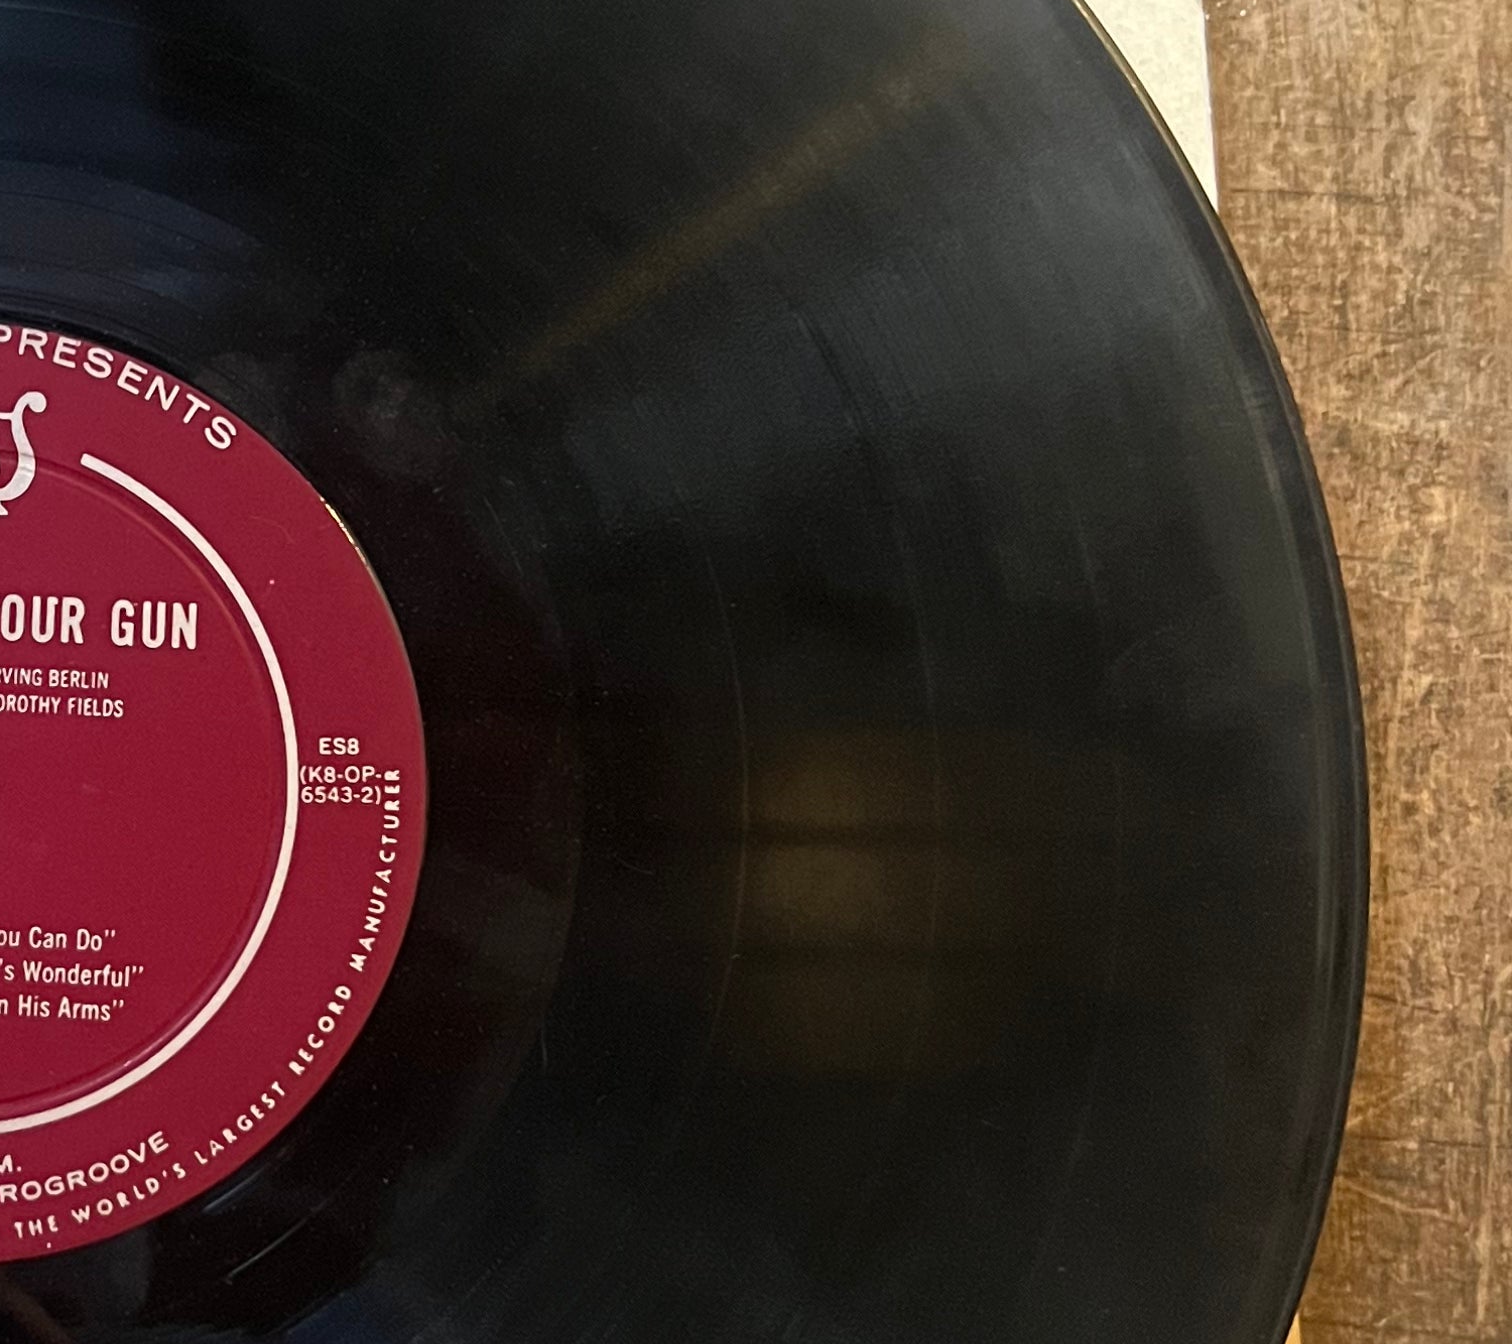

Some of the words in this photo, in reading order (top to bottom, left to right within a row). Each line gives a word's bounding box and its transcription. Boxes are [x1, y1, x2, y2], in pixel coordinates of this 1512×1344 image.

[110, 598, 198, 650] GUN
[48, 668, 109, 689] BERLIN
[67, 696, 124, 719] FIELDS
[318, 736, 360, 756] ES8
[299, 765, 382, 785] (K8-OP-
[300, 785, 382, 806] 6543-2)
[28, 925, 68, 950] Can
[75, 928, 116, 952] Do"
[22, 959, 145, 988] Wonderful"
[13, 1214, 59, 1239] THE
[70, 1162, 187, 1224] WORLD'S
[193, 1080, 286, 1166] LARGEST
[288, 985, 352, 1076] RECORD
[348, 769, 401, 973] MANUFACTURER
[17, 993, 51, 1018] His
[57, 995, 125, 1022] Arms"
